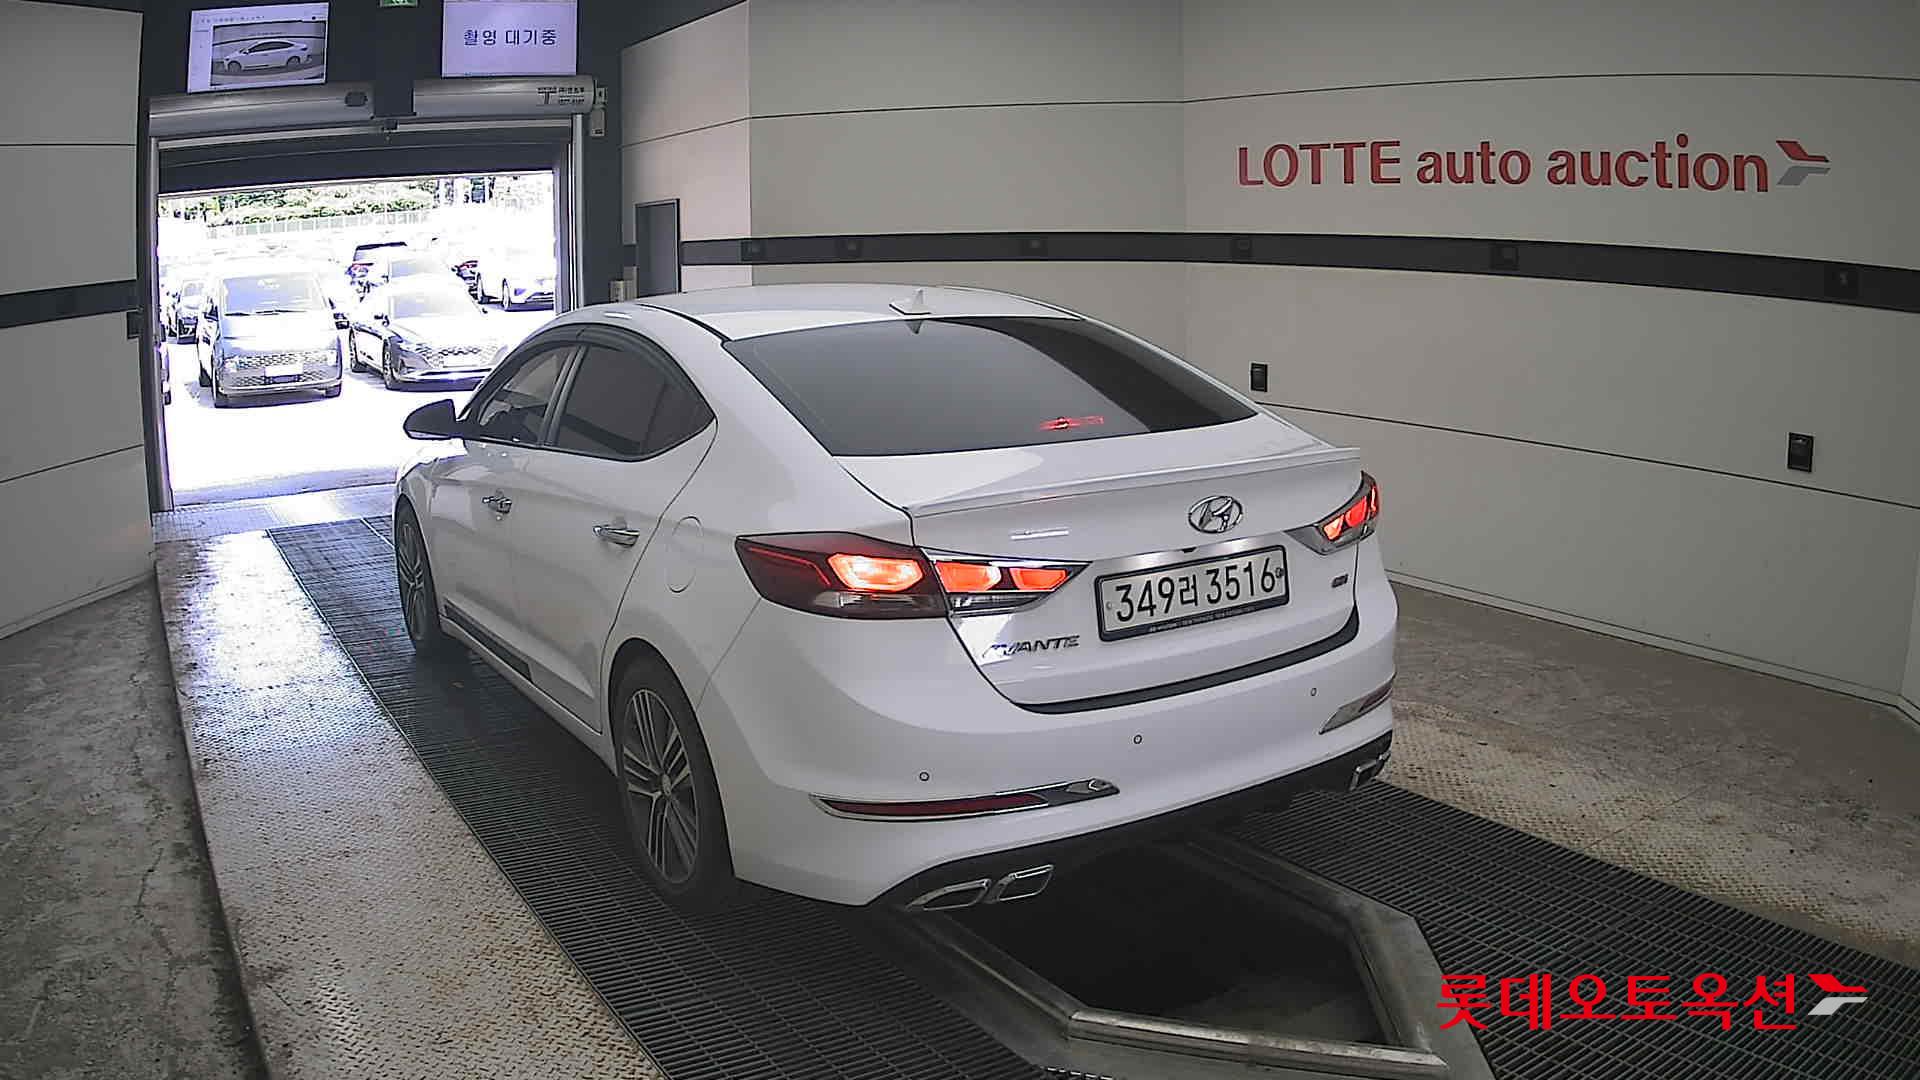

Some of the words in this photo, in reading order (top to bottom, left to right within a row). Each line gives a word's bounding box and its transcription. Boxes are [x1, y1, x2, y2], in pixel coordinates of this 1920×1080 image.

[463, 29, 497, 46] 촬영
[505, 29, 557, 46] 대기중
[1238, 140, 1401, 187] LOTTE
[1416, 140, 1531, 186] auto
[1547, 133, 1768, 192] auction
[1115, 574, 1198, 622] 349러
[1206, 557, 1276, 604] 3516
